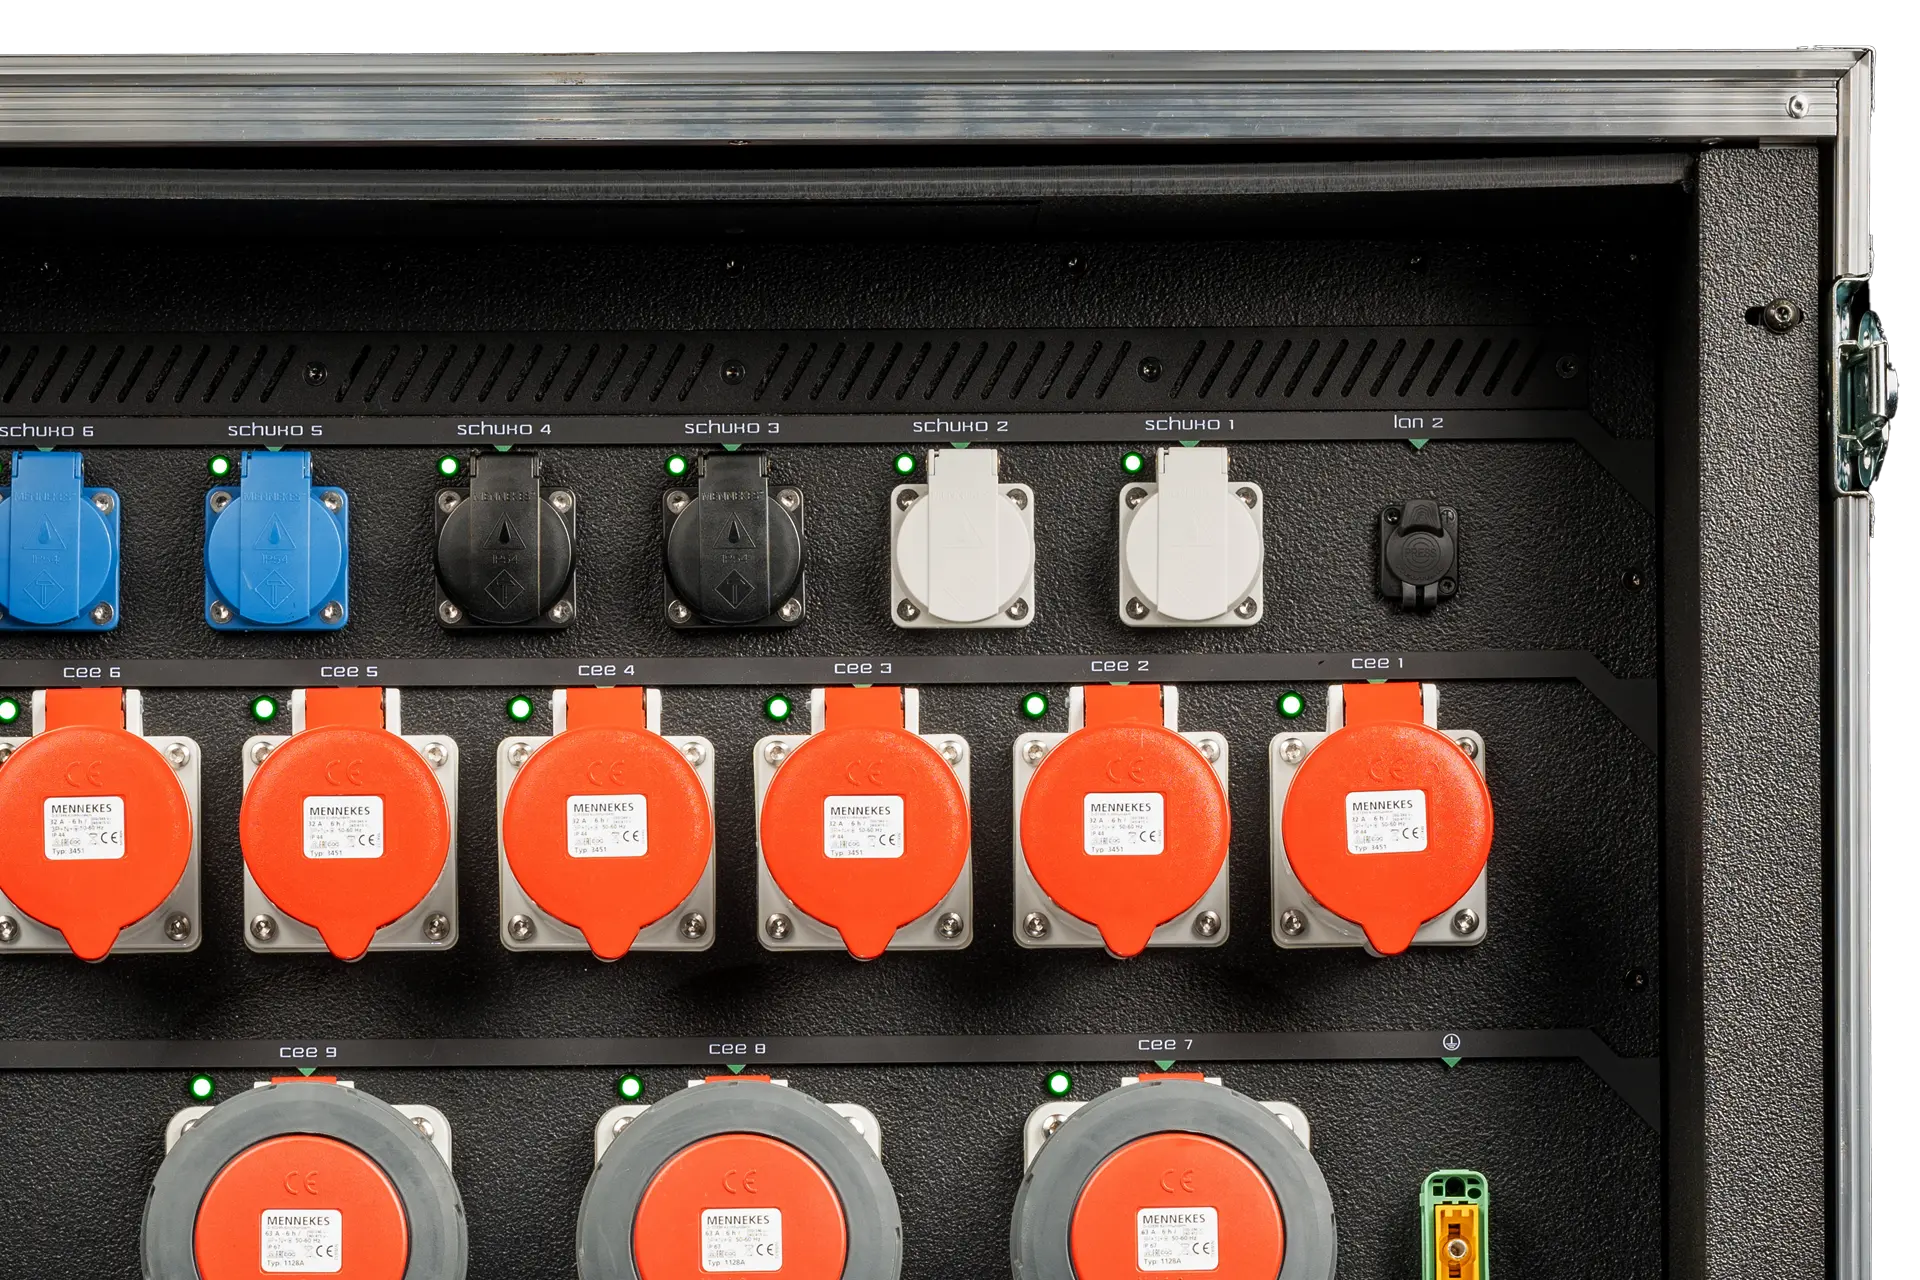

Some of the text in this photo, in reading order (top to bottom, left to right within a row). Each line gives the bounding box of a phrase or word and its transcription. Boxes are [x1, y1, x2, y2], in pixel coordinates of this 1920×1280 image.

[996, 421, 1009, 432] 2
[1228, 419, 1234, 430] 1
[1394, 414, 1444, 429] lan 2
[82, 425, 94, 437] 6
[311, 425, 323, 437] 5
[539, 423, 552, 435] 4
[767, 422, 780, 434] 3
[1404, 547, 1437, 558] PRESS
[834, 662, 892, 674] cee 3
[1091, 660, 1150, 672] cee 2
[1351, 657, 1403, 669] cee 1
[63, 666, 121, 678] cee 6
[320, 666, 378, 678] cee 5
[578, 664, 635, 676] cee 4
[65, 761, 103, 787] CE
[325, 759, 363, 785] CE
[587, 760, 625, 786] CE
[846, 759, 883, 786] CE
[1106, 756, 1145, 784] CE
[1368, 757, 1405, 782] CE
[51, 804, 112, 814] MENNEKES
[309, 806, 370, 815] MENNEKES
[573, 803, 634, 812] MENNEKES
[830, 806, 891, 815] MENNEKES
[1091, 803, 1152, 812] MENNEKES
[1352, 800, 1413, 811] MENNEKES
[100, 832, 118, 844] CE
[622, 830, 640, 842] CE
[1139, 831, 1156, 842] CE
[1402, 827, 1419, 839] CE
[358, 834, 375, 846] CE
[879, 834, 896, 846] CE
[708, 1043, 766, 1055] cee 8
[1138, 1038, 1193, 1051] cee 7
[279, 1046, 337, 1058] cee 9
[284, 1170, 319, 1195] CE
[722, 1169, 758, 1194] CE
[1160, 1168, 1195, 1193] CE
[267, 1216, 330, 1226] MENNEKES
[707, 1215, 770, 1225] MENNEKES
[1142, 1214, 1206, 1224] MENNEKES
[315, 1245, 333, 1257] CE
[756, 1244, 774, 1256] CE
[1192, 1242, 1210, 1255] CE
